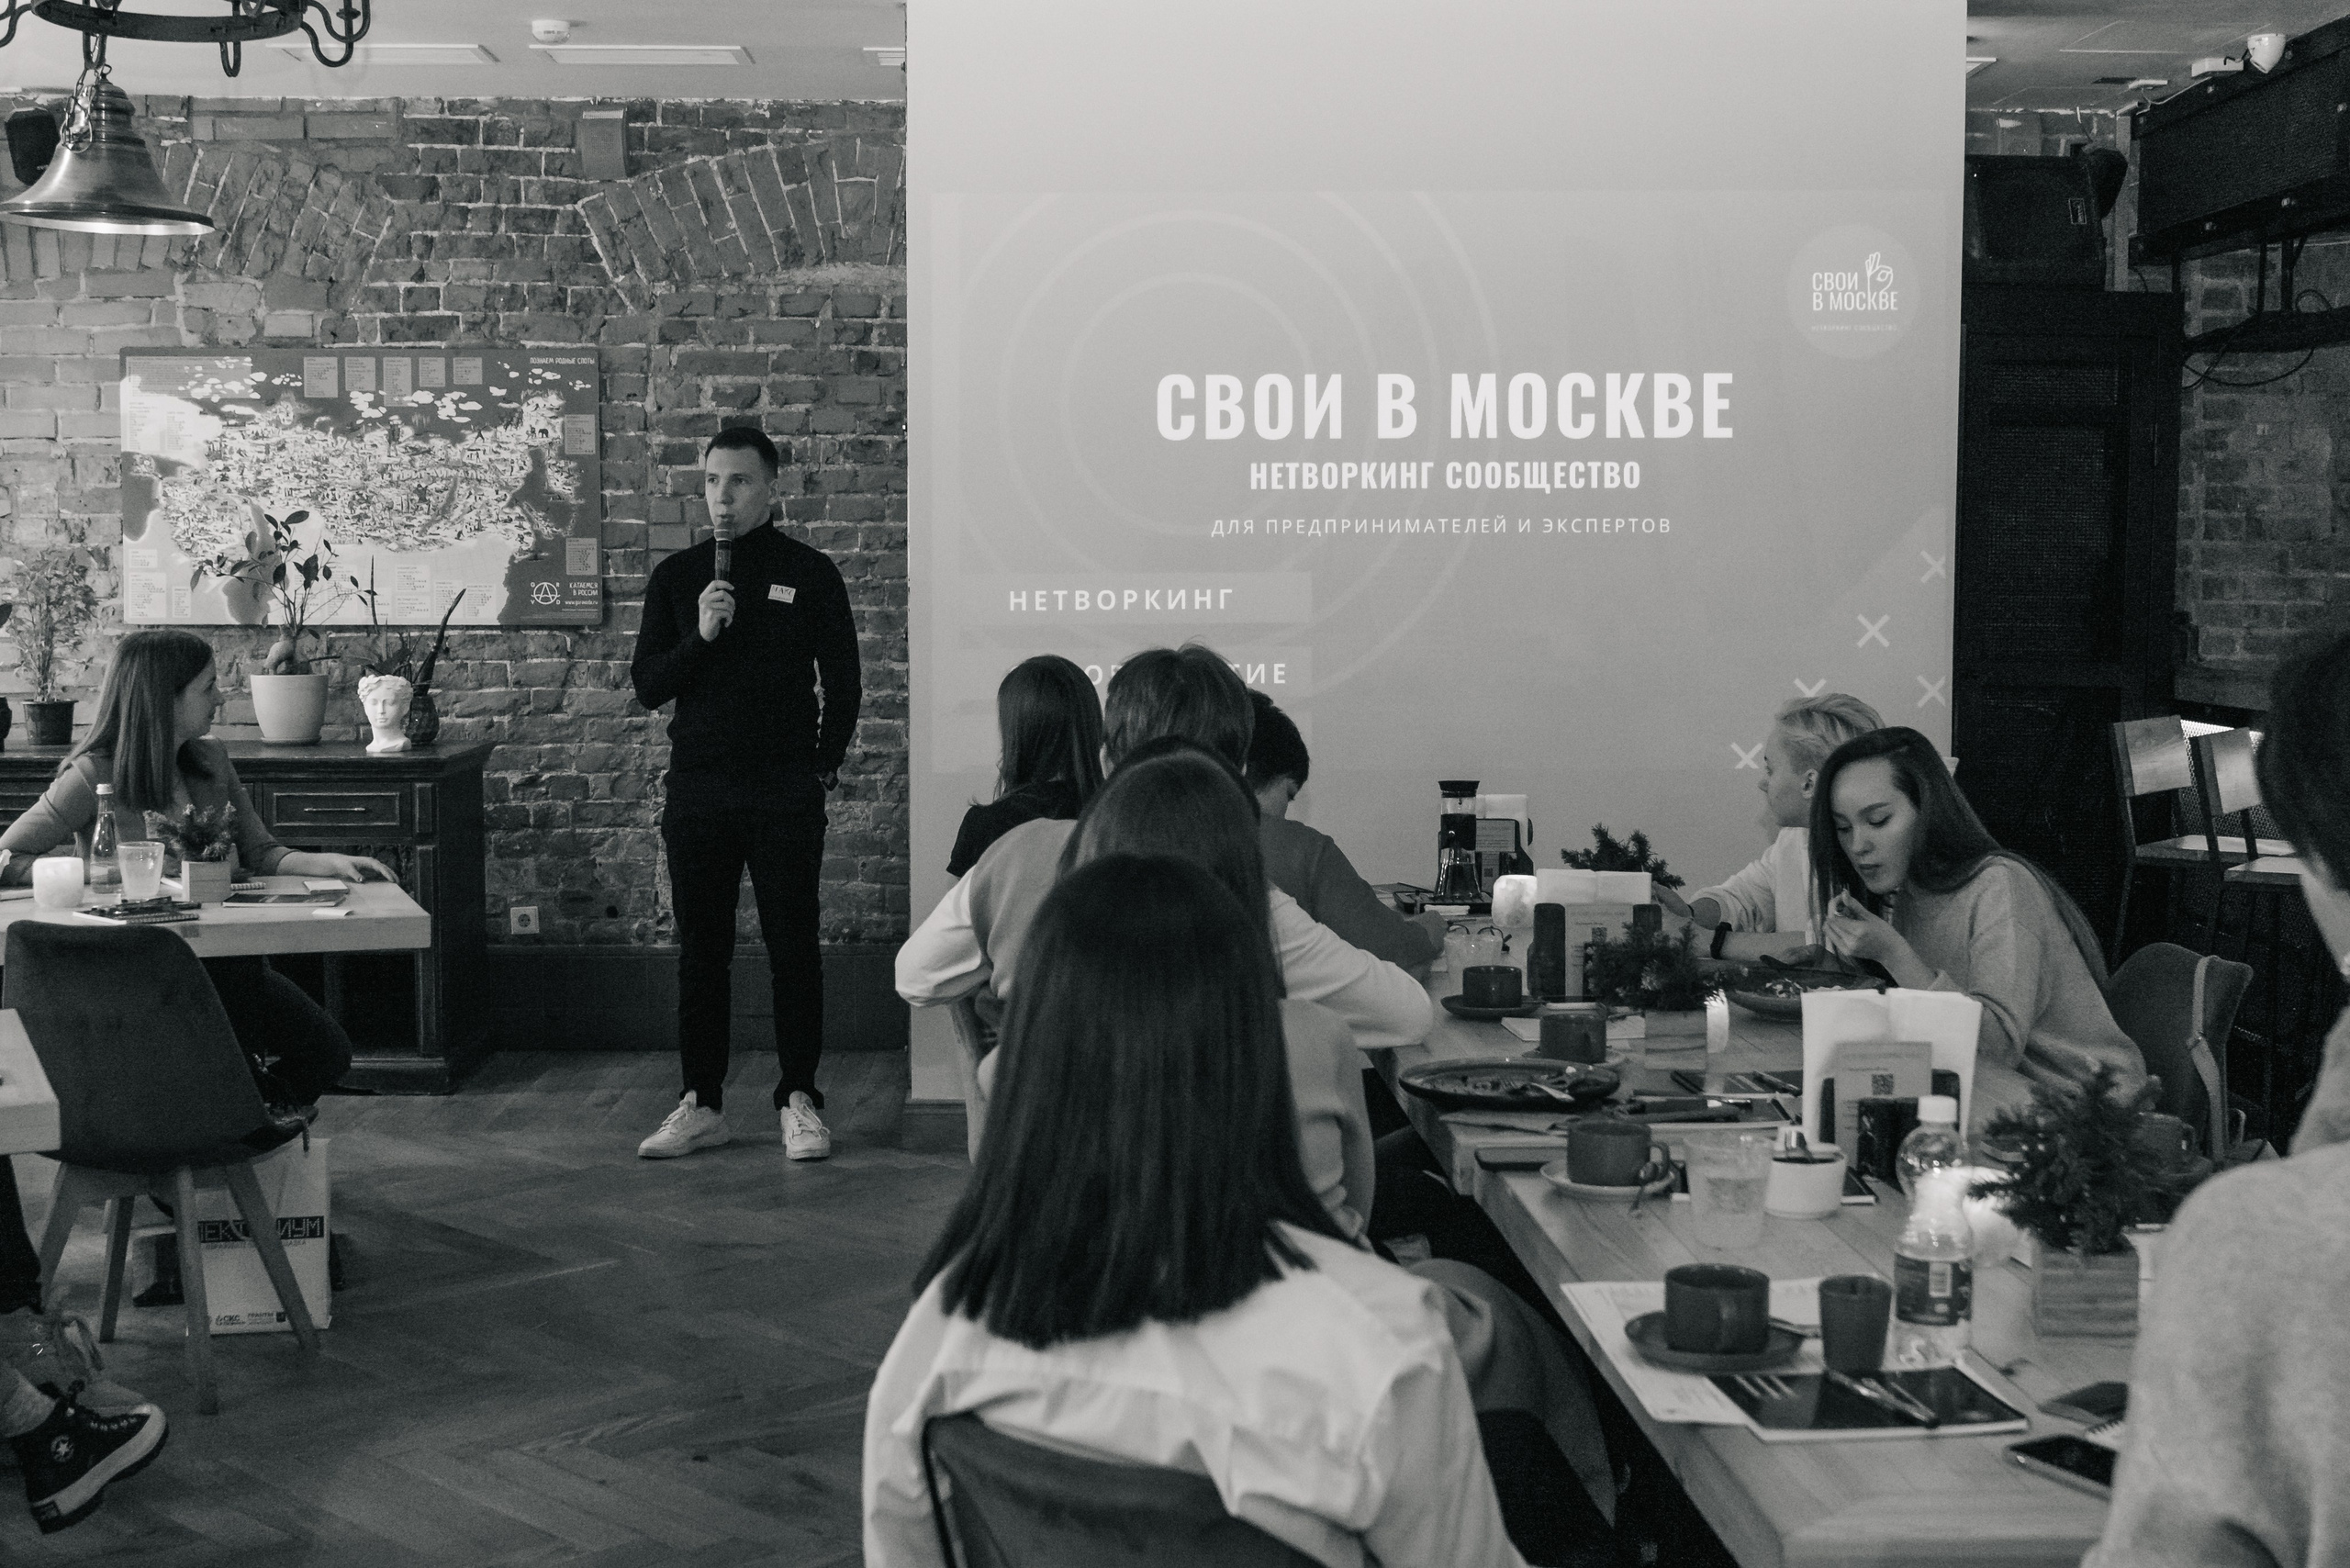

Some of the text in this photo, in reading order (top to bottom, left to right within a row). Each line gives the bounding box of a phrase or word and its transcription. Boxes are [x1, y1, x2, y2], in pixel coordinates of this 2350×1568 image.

[1812, 272, 1858, 291] СВОИ
[1812, 291, 1898, 311] В МОСКВЕ
[1157, 371, 1734, 441] СВОИ В МОСКВЕ
[1250, 461, 1641, 494] НЕТВОРКИНГ СООБЩЕСТВО
[1210, 514, 1671, 539] ДЛЯ ПРЕДПРИНИМАТЕЛЕЙ И ЭКСПЕРТОВ
[1010, 588, 1233, 611] НЕТВОРКИНГ
